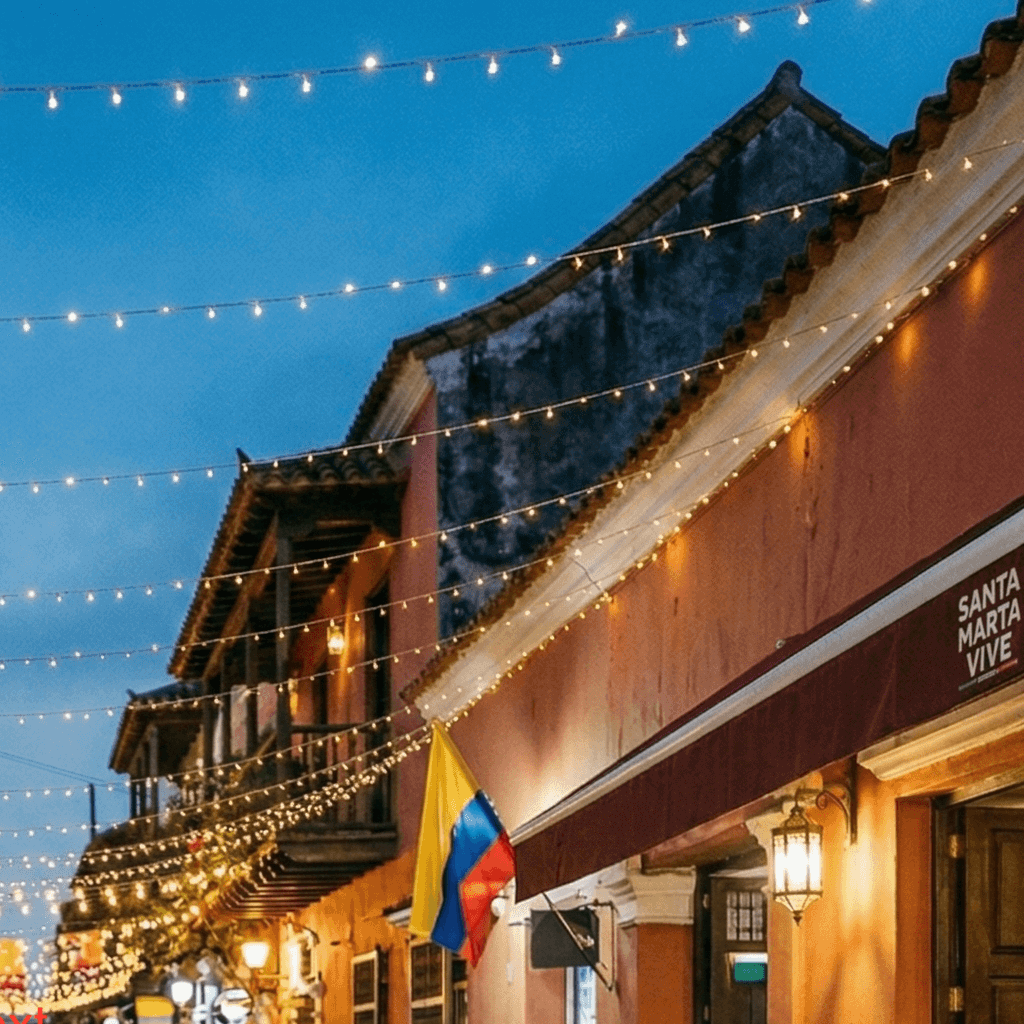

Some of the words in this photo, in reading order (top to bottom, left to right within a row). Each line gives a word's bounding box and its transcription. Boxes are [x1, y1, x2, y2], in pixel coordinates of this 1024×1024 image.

[958, 567, 1021, 623] SANTA
[958, 597, 1021, 653] MARTA
[966, 631, 1012, 678] VIVE
